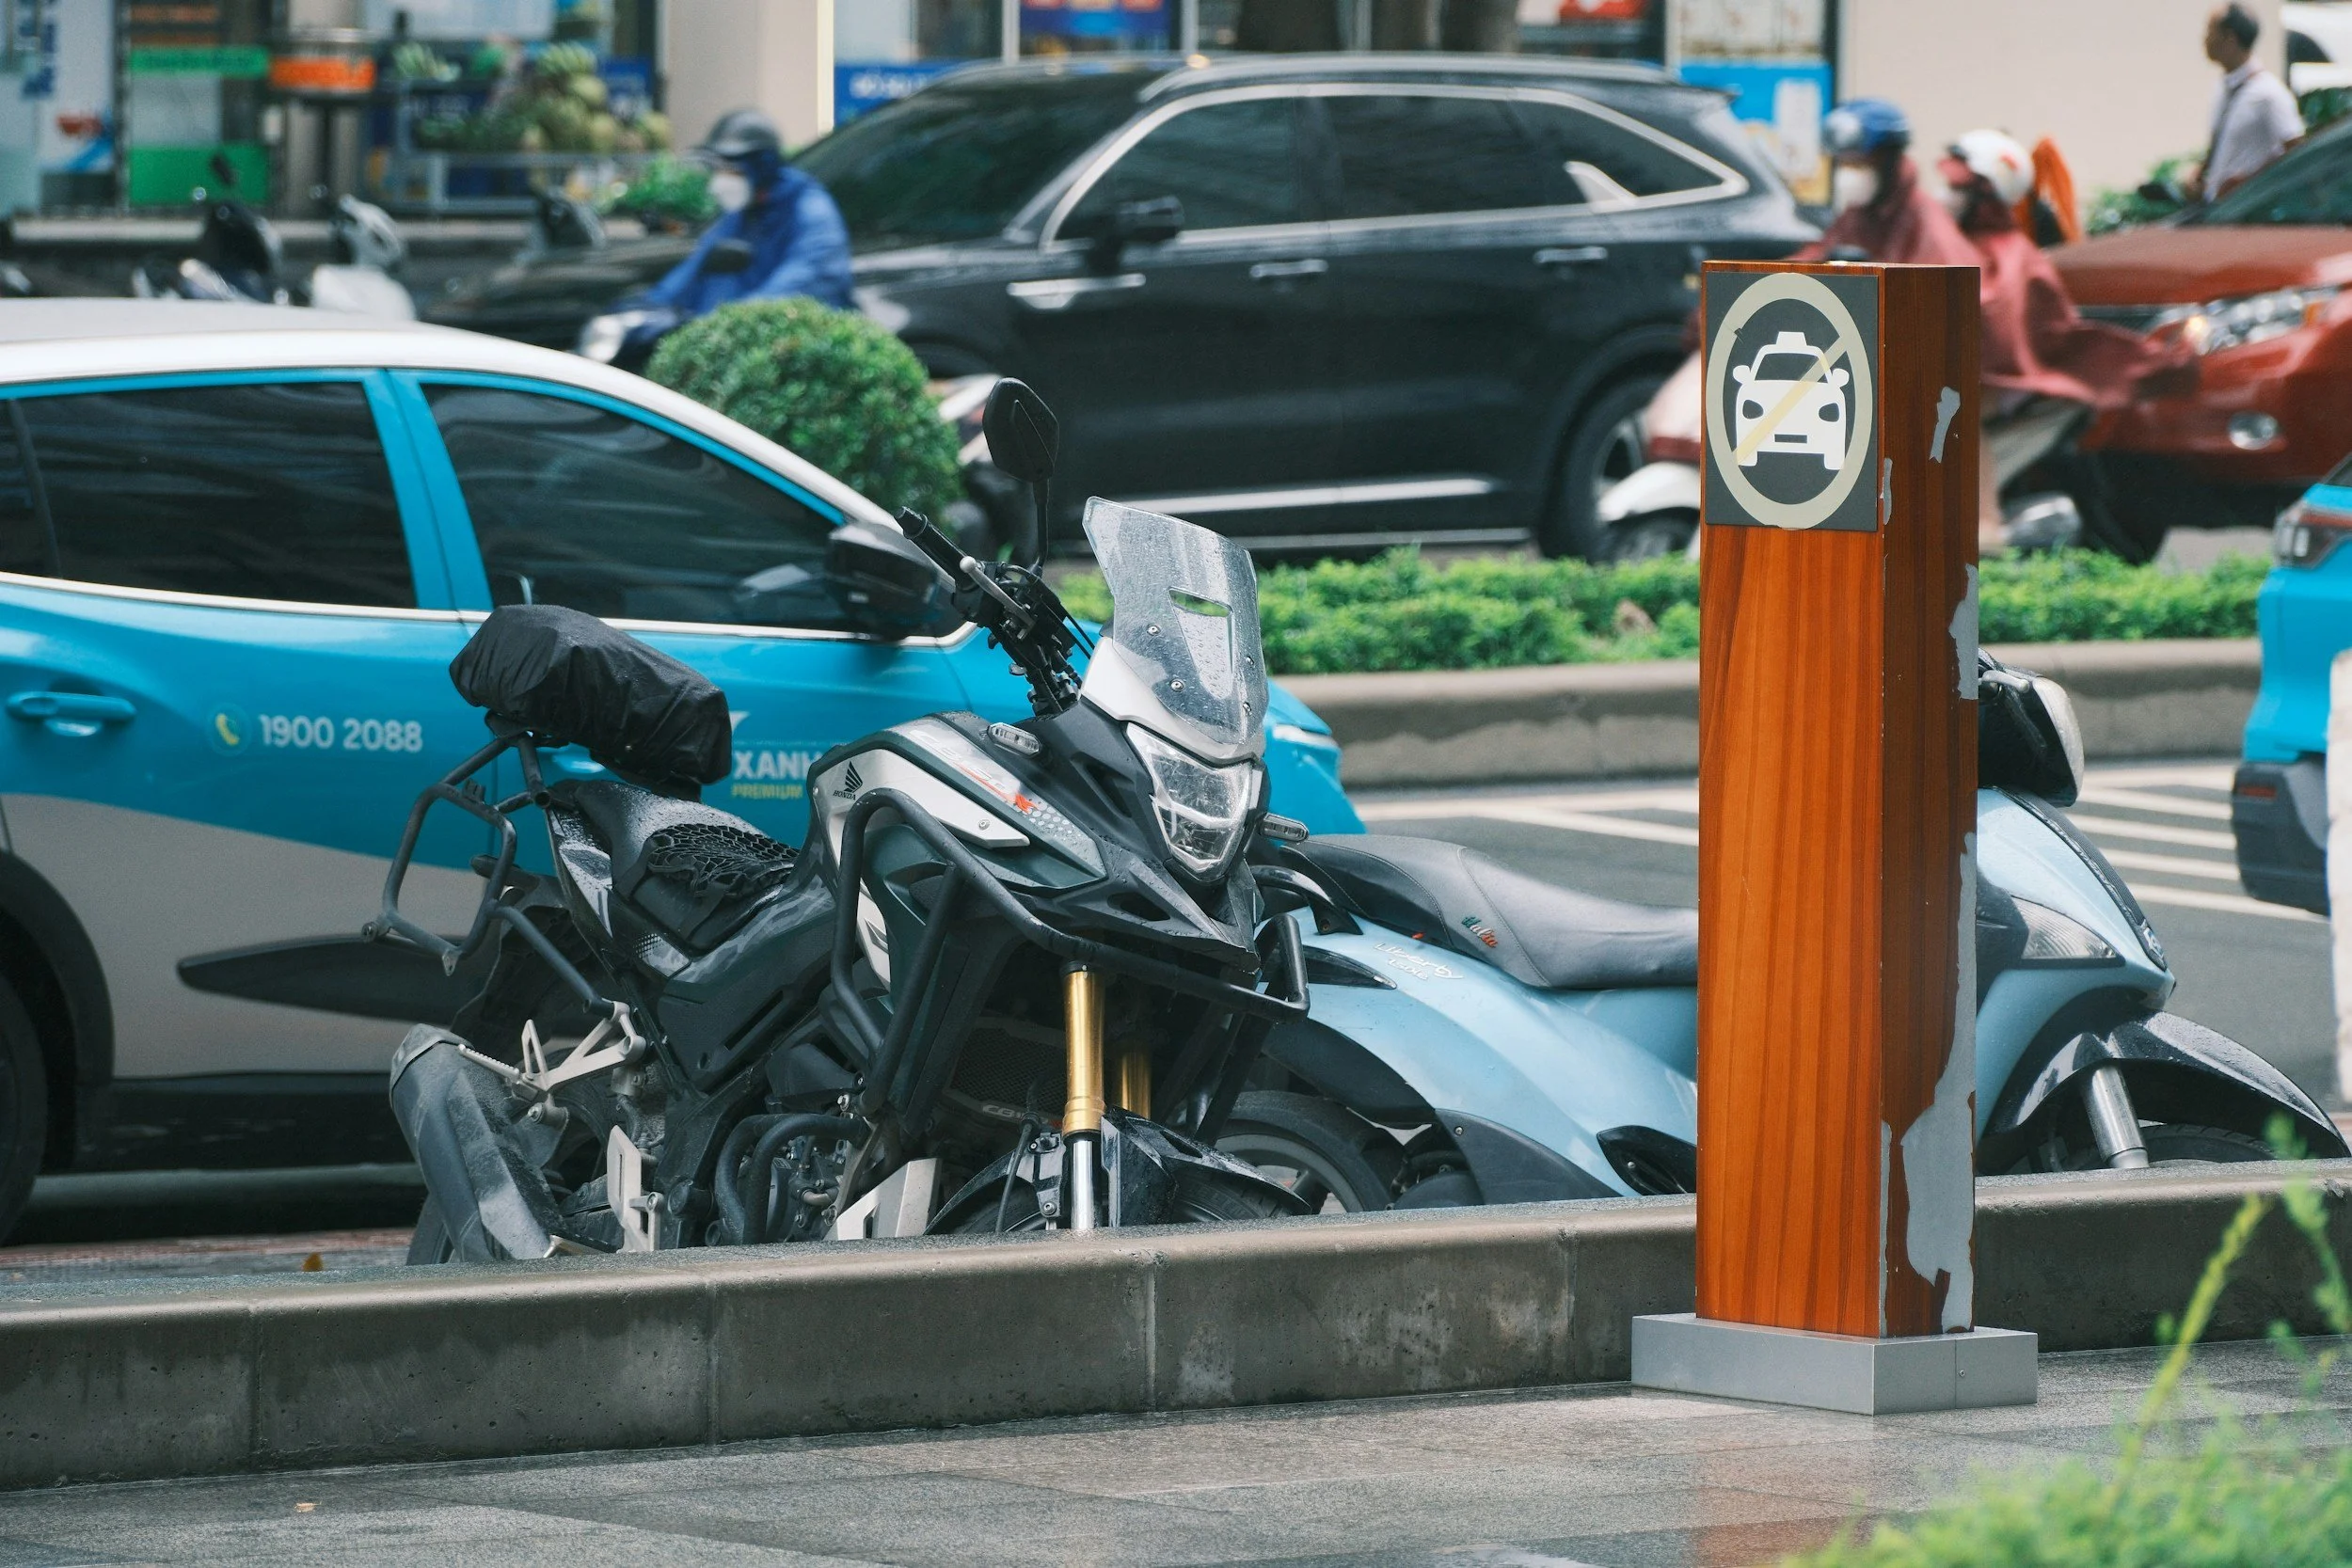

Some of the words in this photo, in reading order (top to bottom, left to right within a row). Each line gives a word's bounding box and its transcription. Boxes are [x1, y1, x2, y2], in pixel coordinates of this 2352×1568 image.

[258, 714, 334, 749] 1900
[342, 718, 422, 752] 2088
[732, 784, 803, 800] PREMIUM
[833, 790, 856, 800] HONDA
